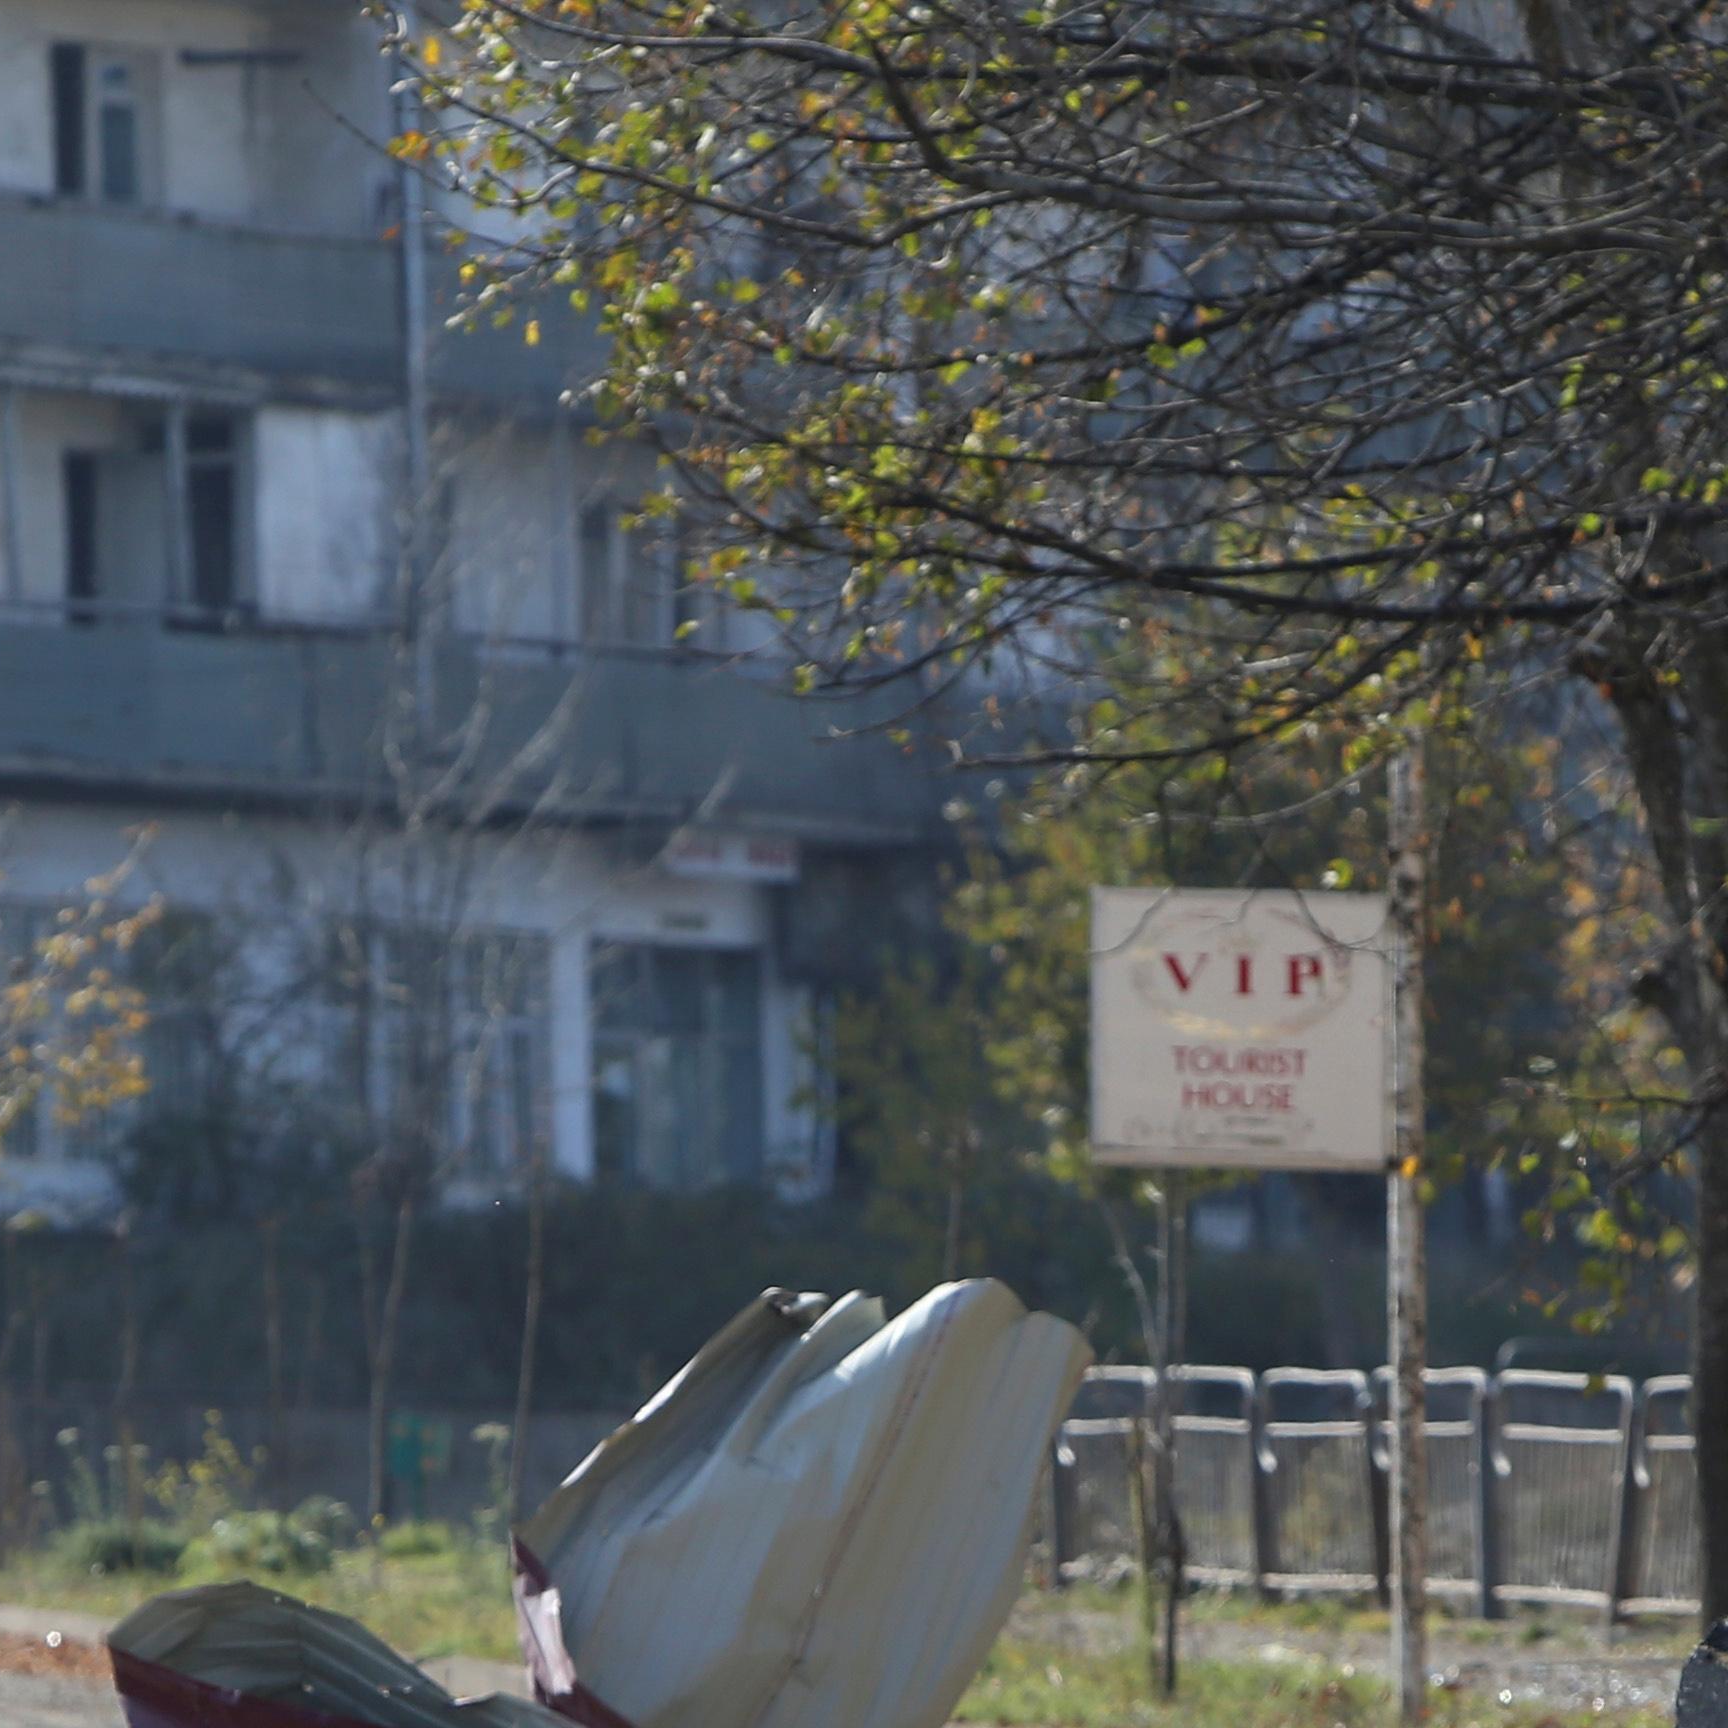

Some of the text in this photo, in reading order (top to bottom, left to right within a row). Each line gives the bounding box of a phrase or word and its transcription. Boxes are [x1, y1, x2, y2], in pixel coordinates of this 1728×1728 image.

[1162, 952, 1323, 997] VIP
[1173, 1045, 1305, 1077] TOURIST
[1181, 1081, 1294, 1111] HOUSE
